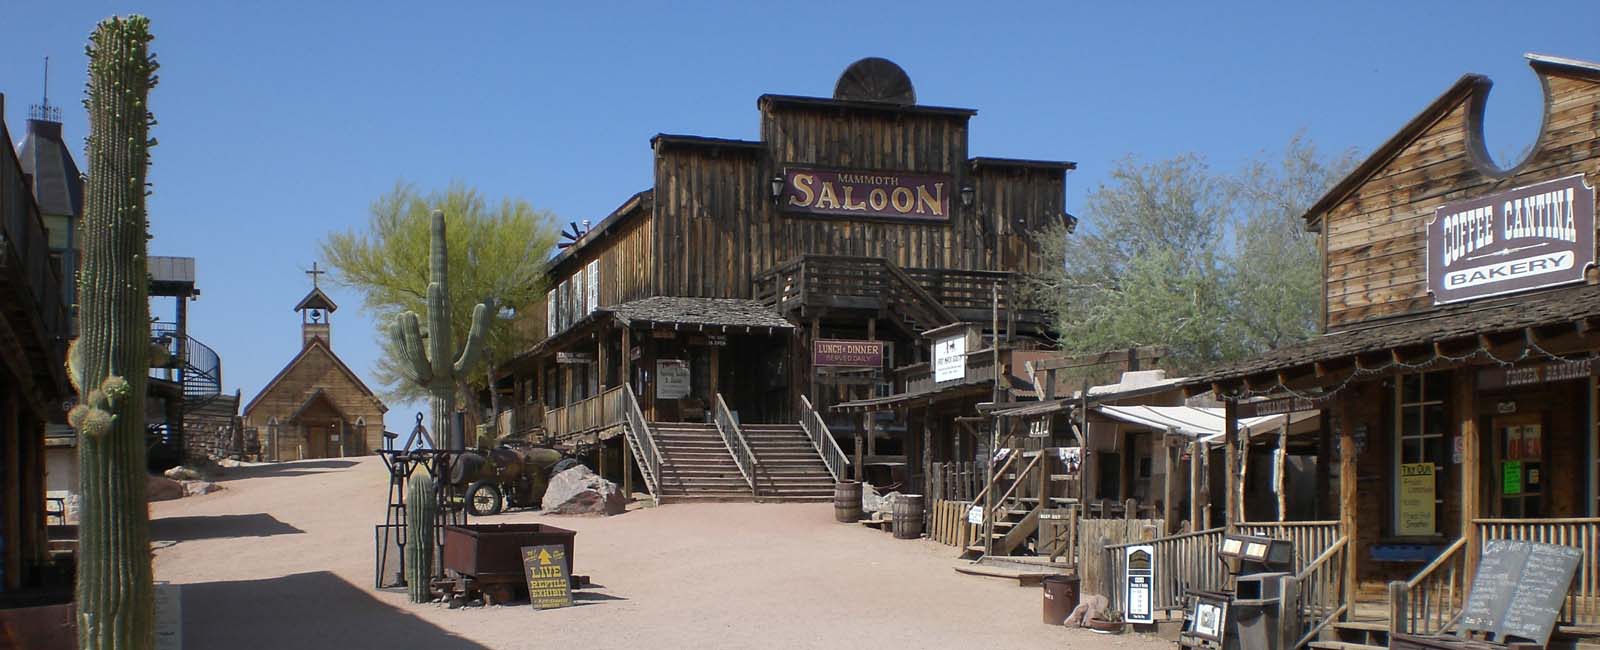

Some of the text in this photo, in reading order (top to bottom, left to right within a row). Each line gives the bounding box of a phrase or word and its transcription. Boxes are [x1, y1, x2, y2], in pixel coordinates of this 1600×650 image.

[838, 173, 899, 186] MAMMOTH
[788, 173, 944, 216] SALOON
[1443, 187, 1577, 268] COFFEE CANTINA
[1450, 254, 1567, 286] BAKERY
[818, 344, 842, 354] LUNCH
[847, 345, 879, 354] DINNER
[1506, 359, 1592, 386] FROZEN BANANAS
[530, 565, 562, 578] LIVE
[530, 579, 567, 589] REPTILE
[532, 589, 567, 598] EXHIBIT
